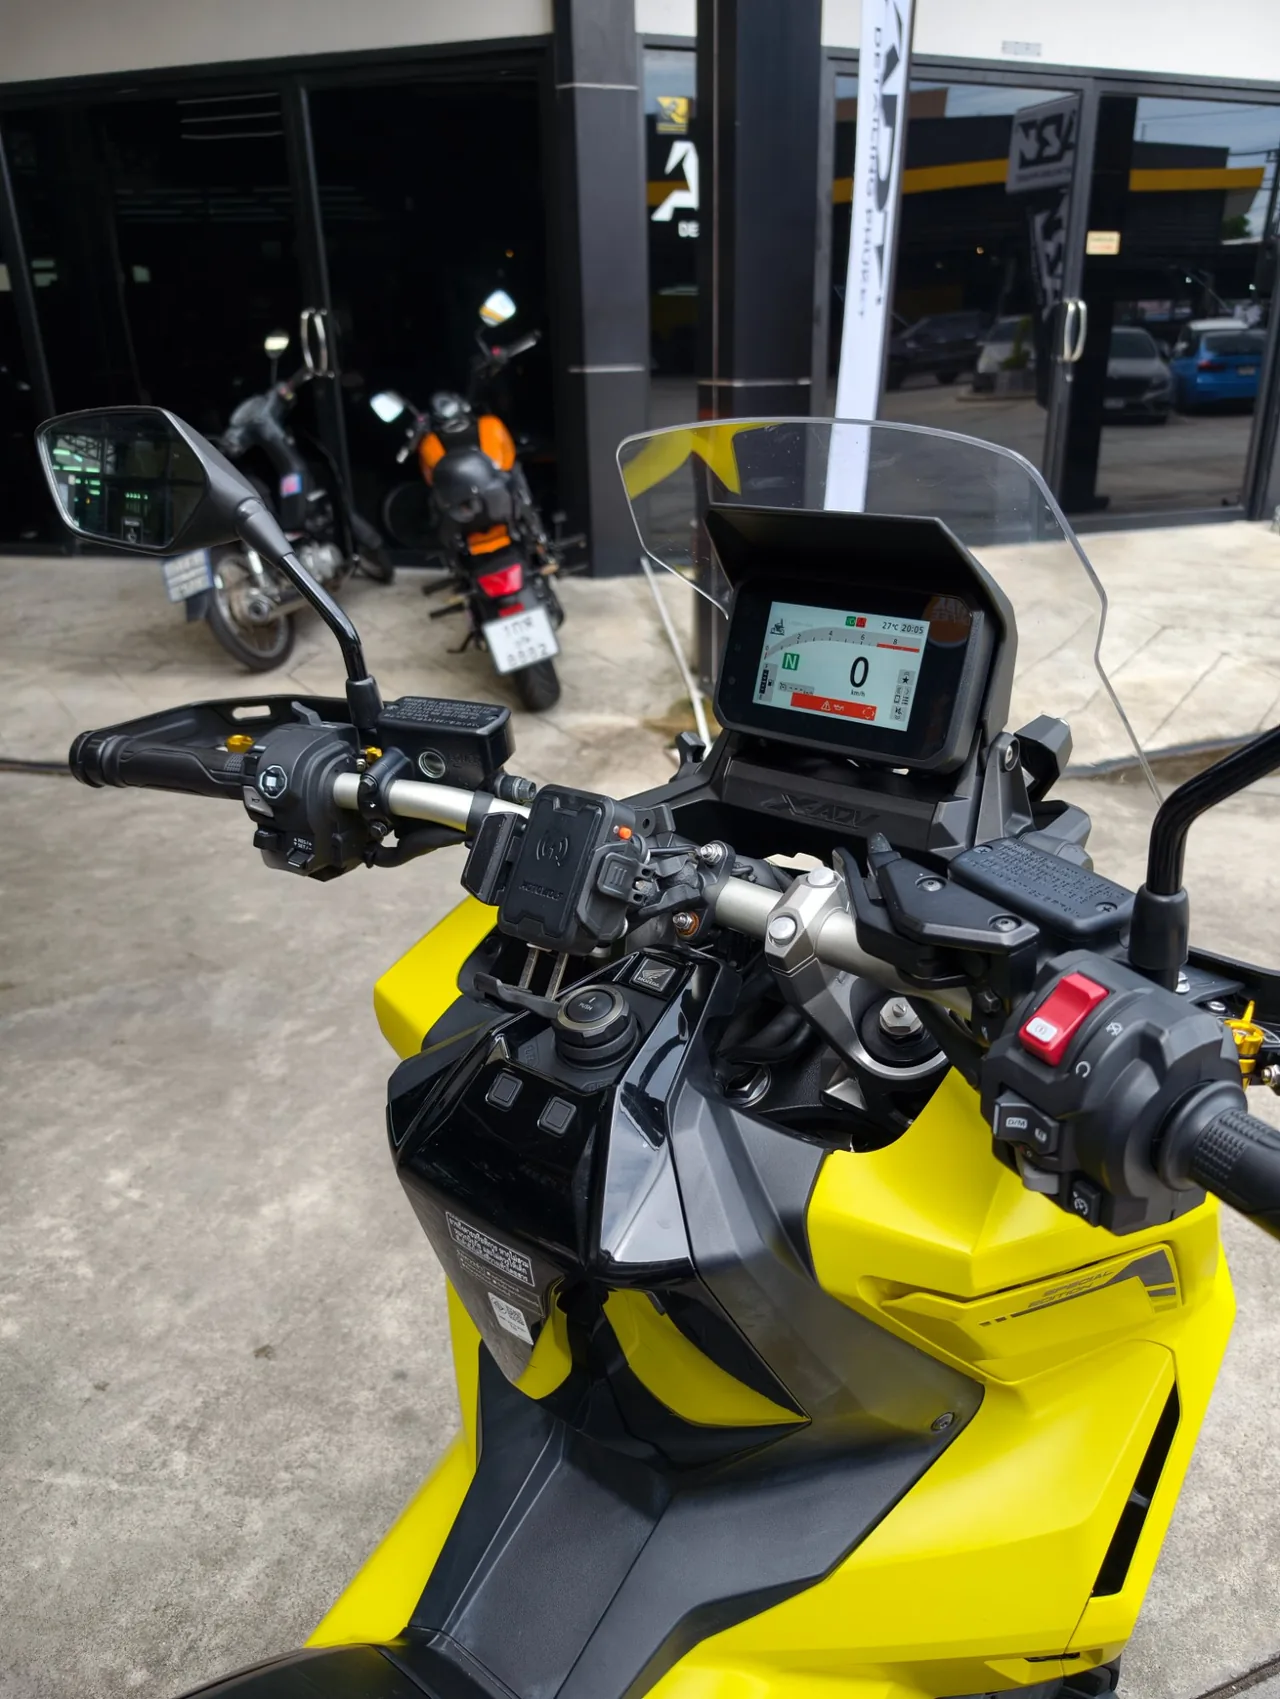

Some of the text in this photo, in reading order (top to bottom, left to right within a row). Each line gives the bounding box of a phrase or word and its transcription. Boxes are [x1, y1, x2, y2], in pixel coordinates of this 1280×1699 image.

[901, 624, 924, 634] 20:05
[784, 654, 798, 670] N
[850, 656, 869, 688] 0
[850, 689, 866, 698] km/h
[637, 976, 660, 988] HONDA
[579, 1002, 593, 1011] PUSH
[1027, 1282, 1094, 1309] EDITION
